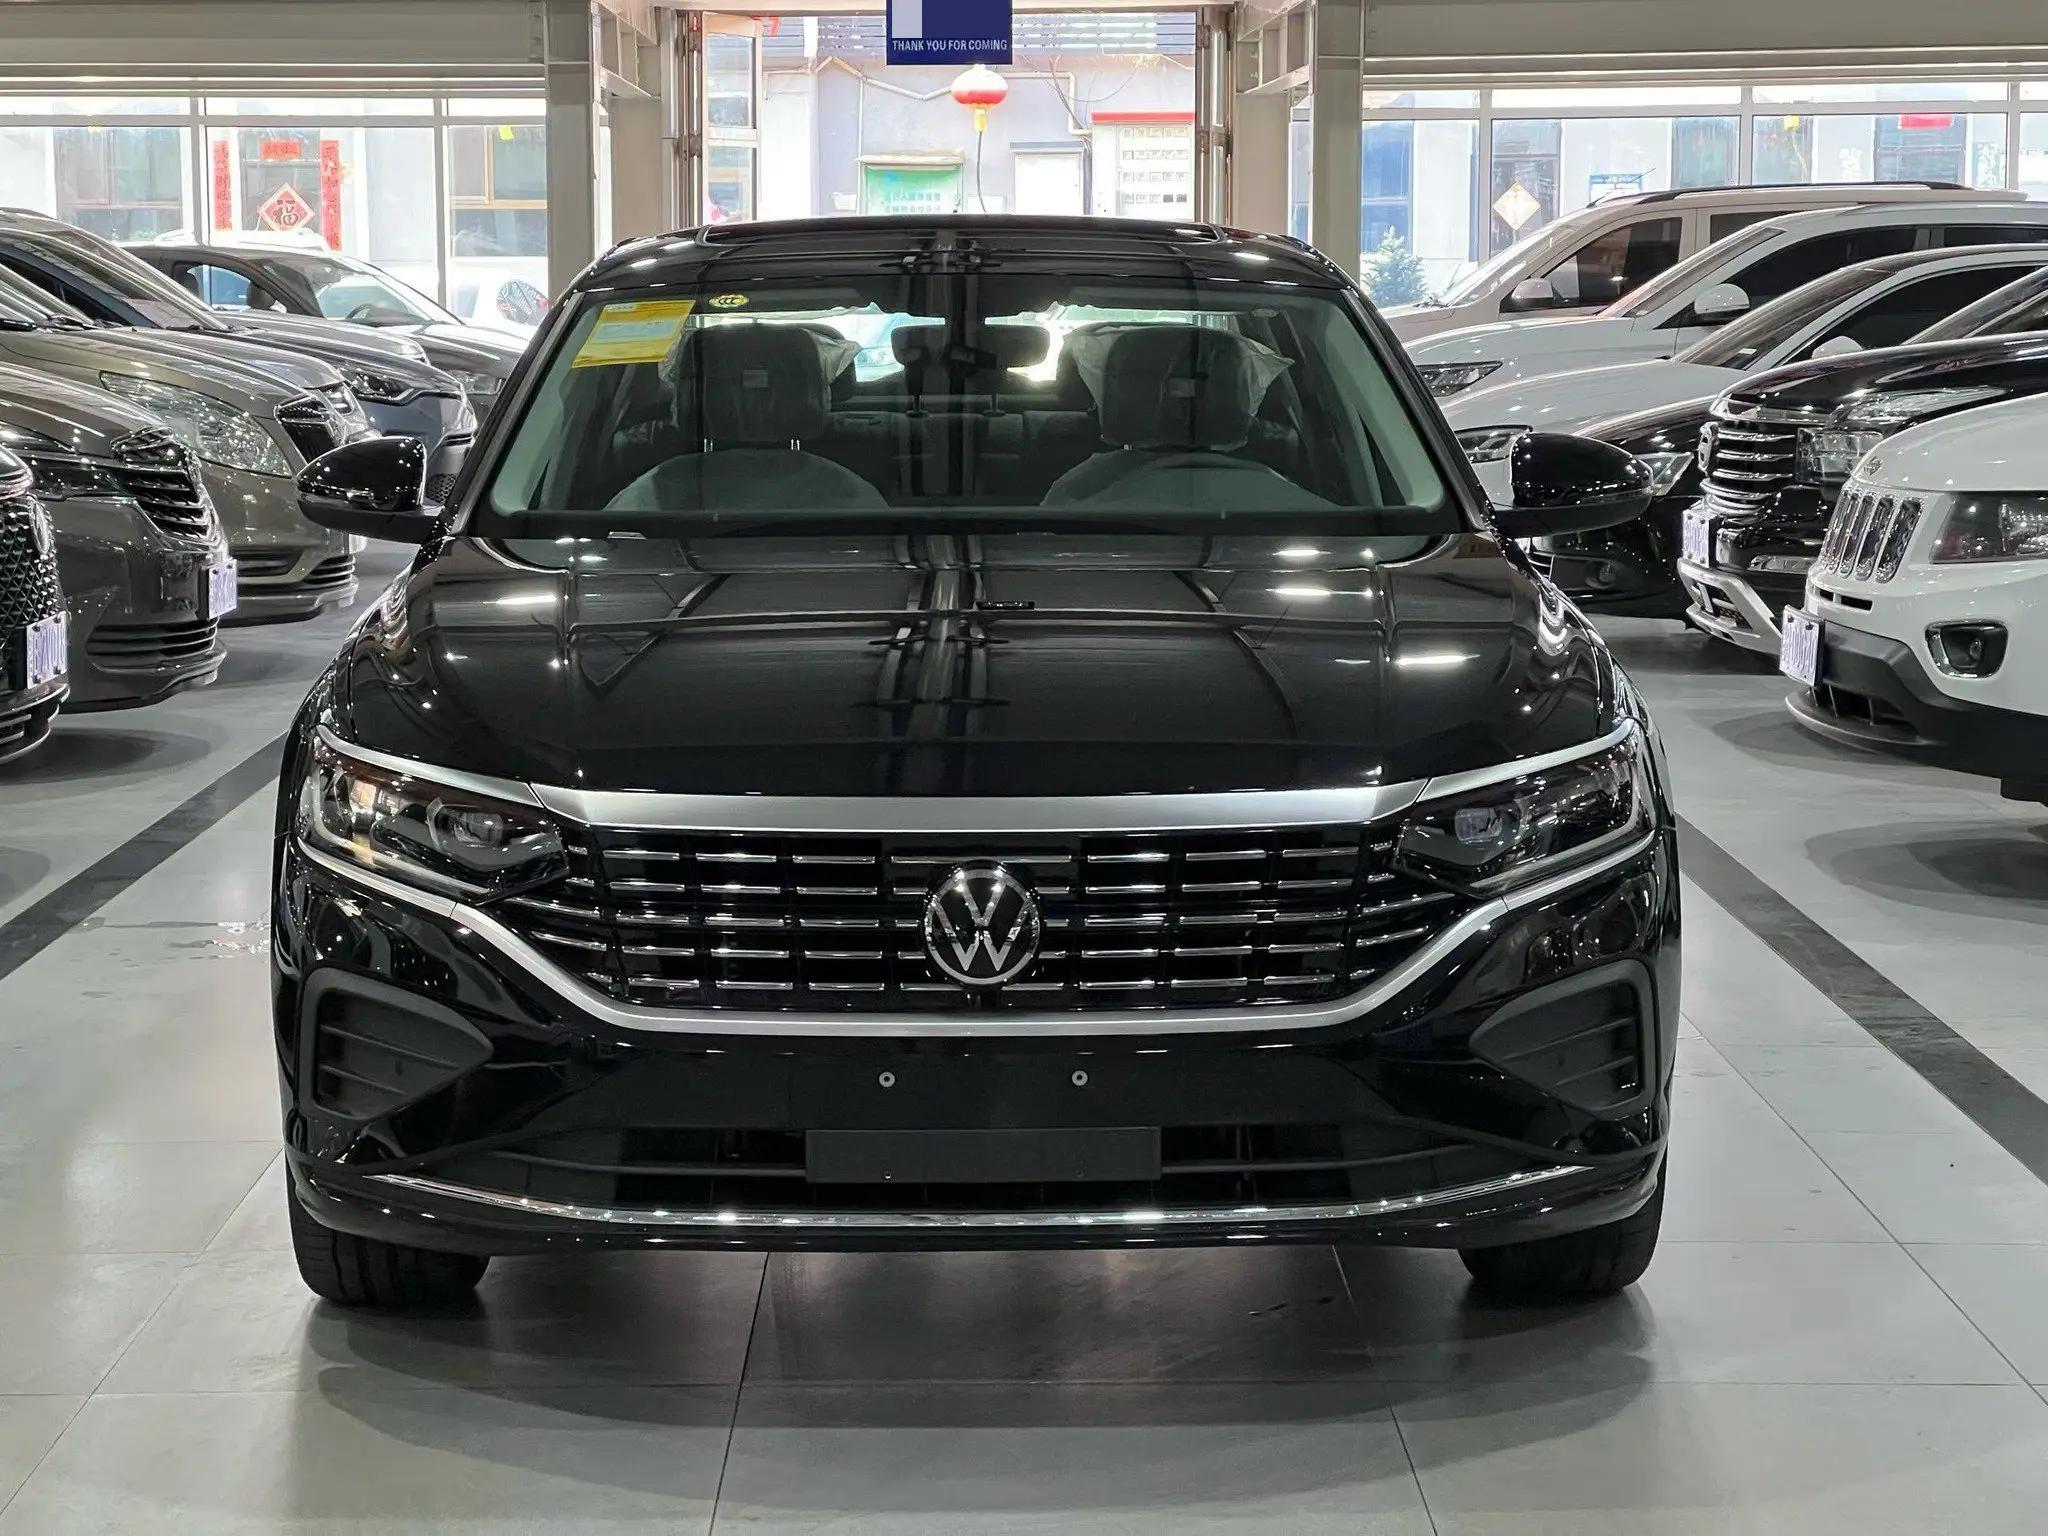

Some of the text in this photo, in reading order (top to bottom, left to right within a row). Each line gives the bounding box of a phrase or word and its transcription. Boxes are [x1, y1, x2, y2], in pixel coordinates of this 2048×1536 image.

[892, 39, 1008, 51] THANK YOU FOR COMING
